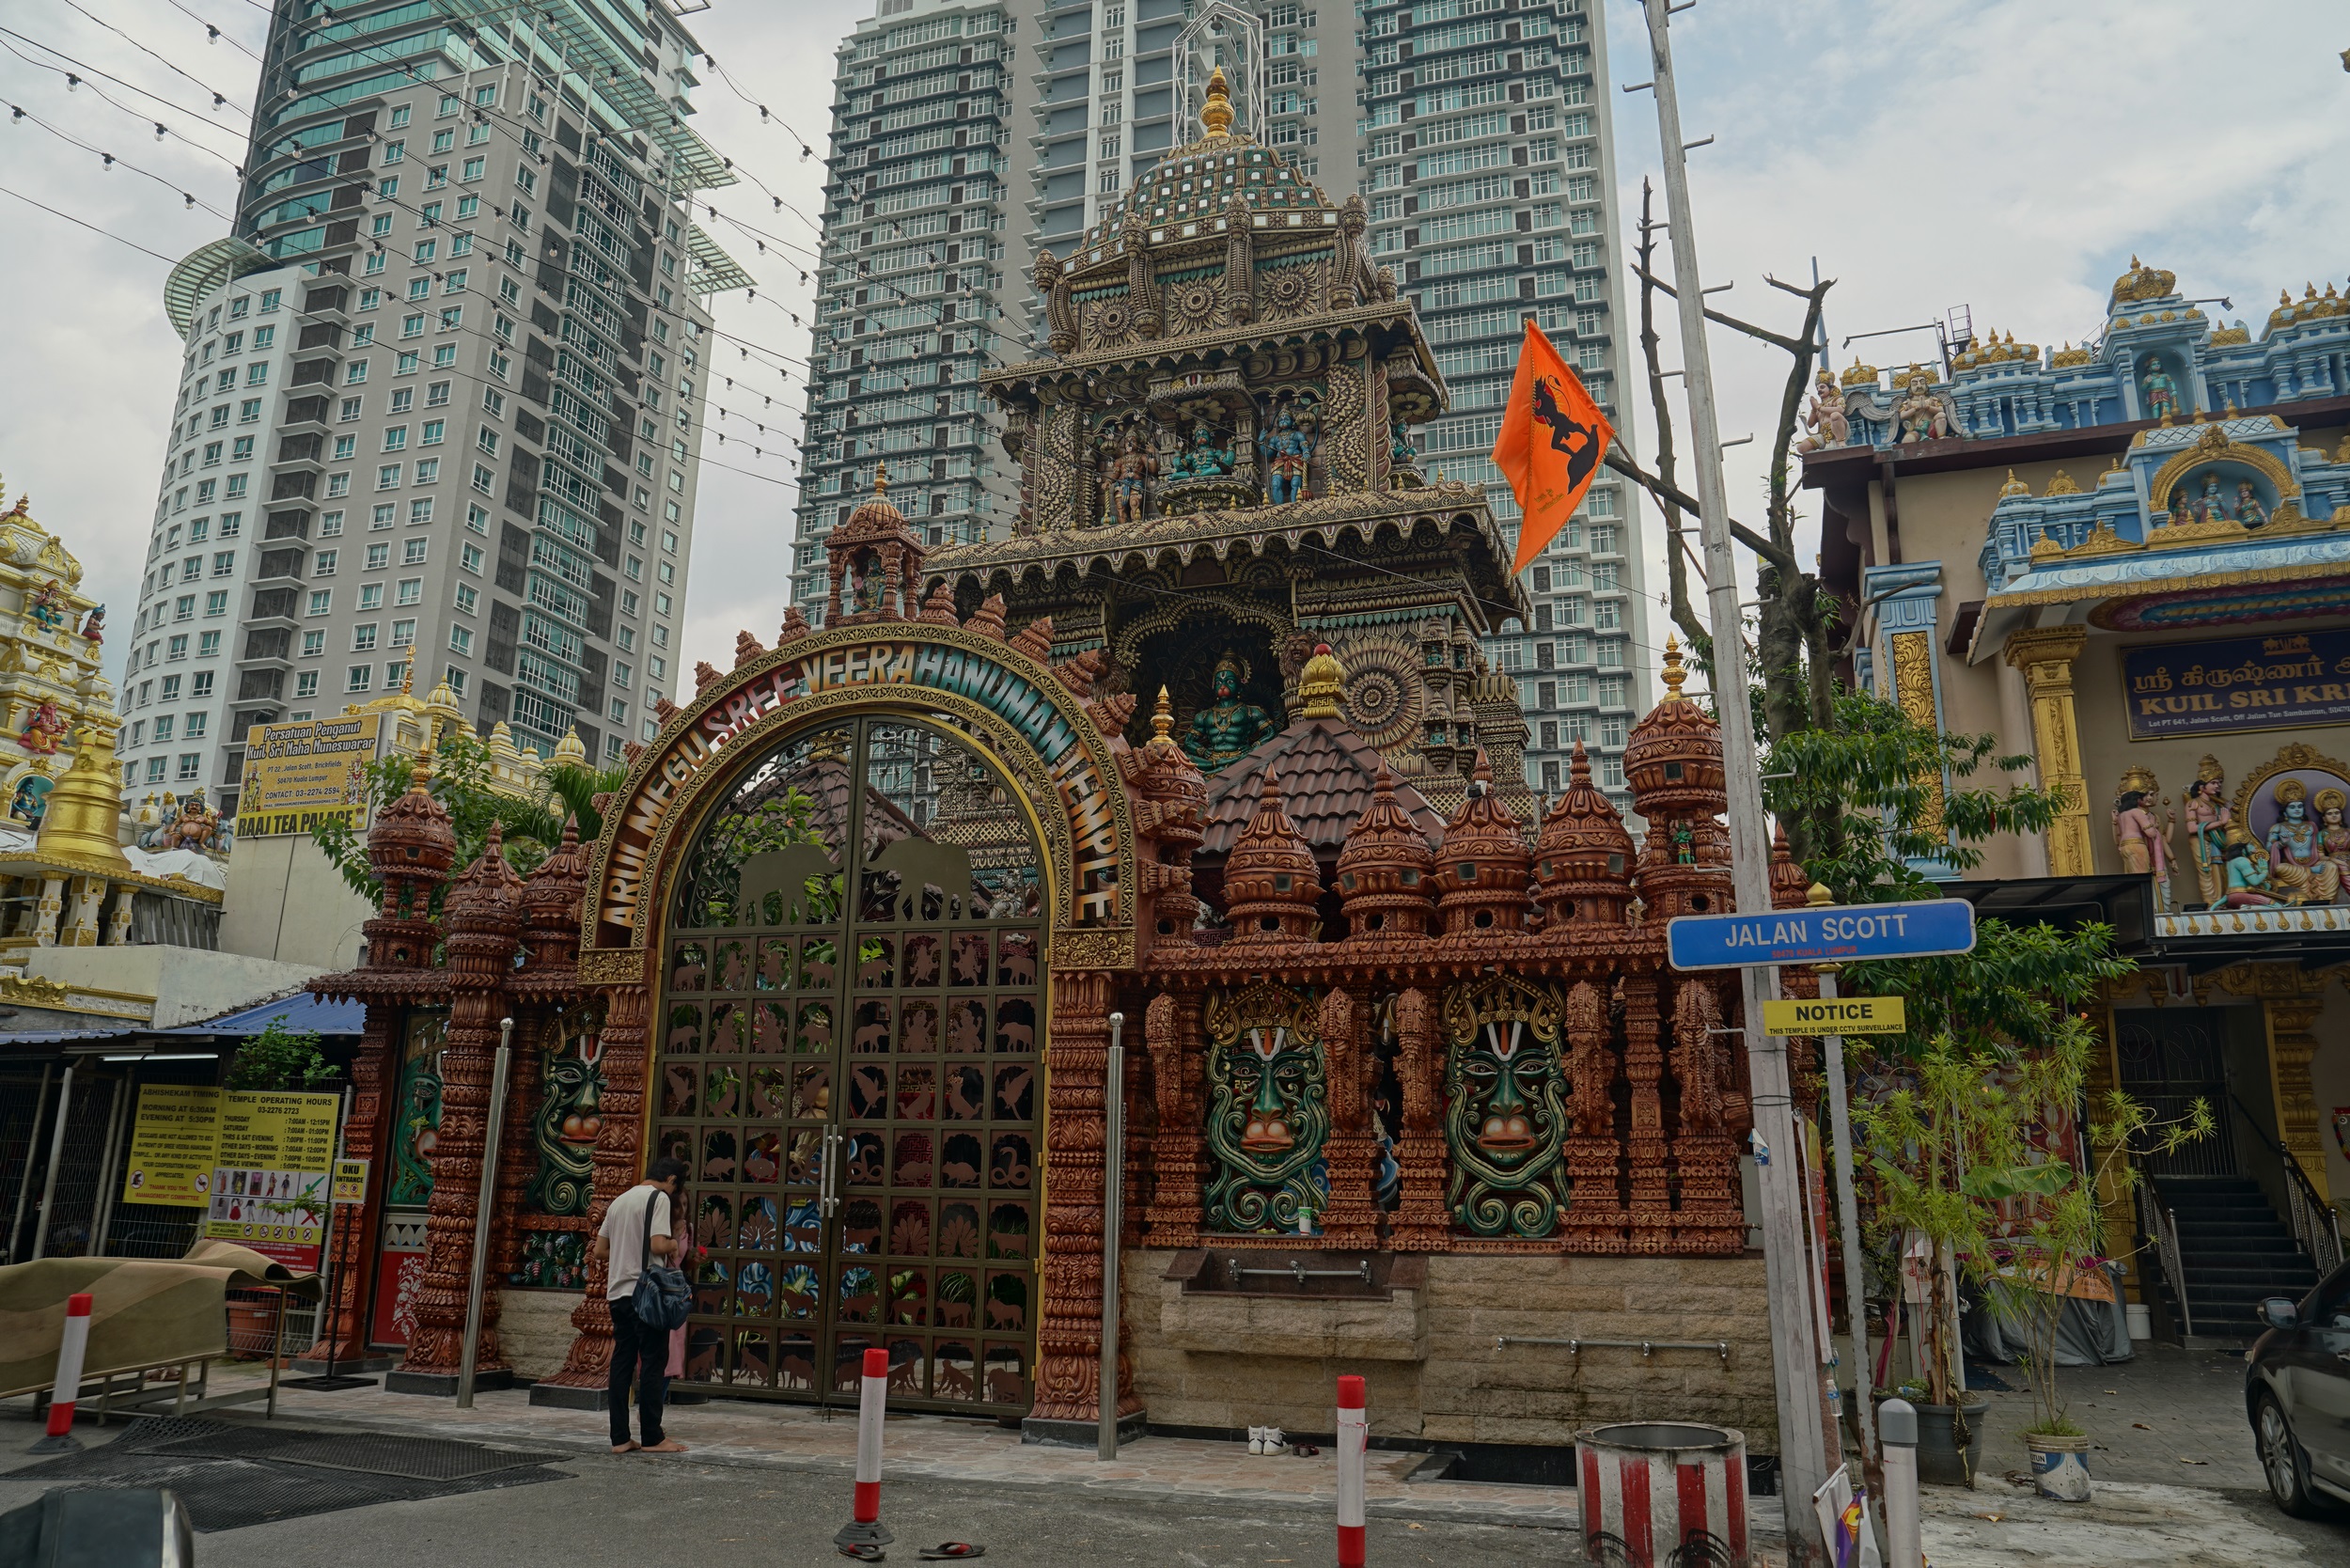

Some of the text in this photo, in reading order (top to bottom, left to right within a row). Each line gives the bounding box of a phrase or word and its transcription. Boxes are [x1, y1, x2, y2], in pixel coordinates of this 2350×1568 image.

[2139, 694, 2222, 715] KUIL
[2230, 688, 2287, 708] SRI
[263, 720, 362, 742] Persatuan Penganut
[247, 738, 375, 760] Kuil Sri Maha Muneswarar
[315, 760, 342, 769] Brickfields
[625, 729, 713, 838] MEGU
[703, 666, 800, 745] SREE
[800, 644, 916, 693] VEERA
[914, 645, 1077, 764] HANUMAN
[1053, 740, 1119, 922] TEMPLE
[265, 790, 293, 799] CONTACT:
[295, 788, 322, 797] 03-2274
[237, 816, 271, 837] RAAJ
[274, 814, 297, 834] TEA
[1726, 914, 1908, 948] JALAN SCOTT
[1772, 946, 1857, 959] 50470 KUALA LUMPUR
[1795, 1004, 1872, 1021] NOTICE
[143, 1089, 191, 1097] ABHISHEKAM
[260, 1096, 302, 1105] OPERATING
[342, 1165, 359, 1174] OKU
